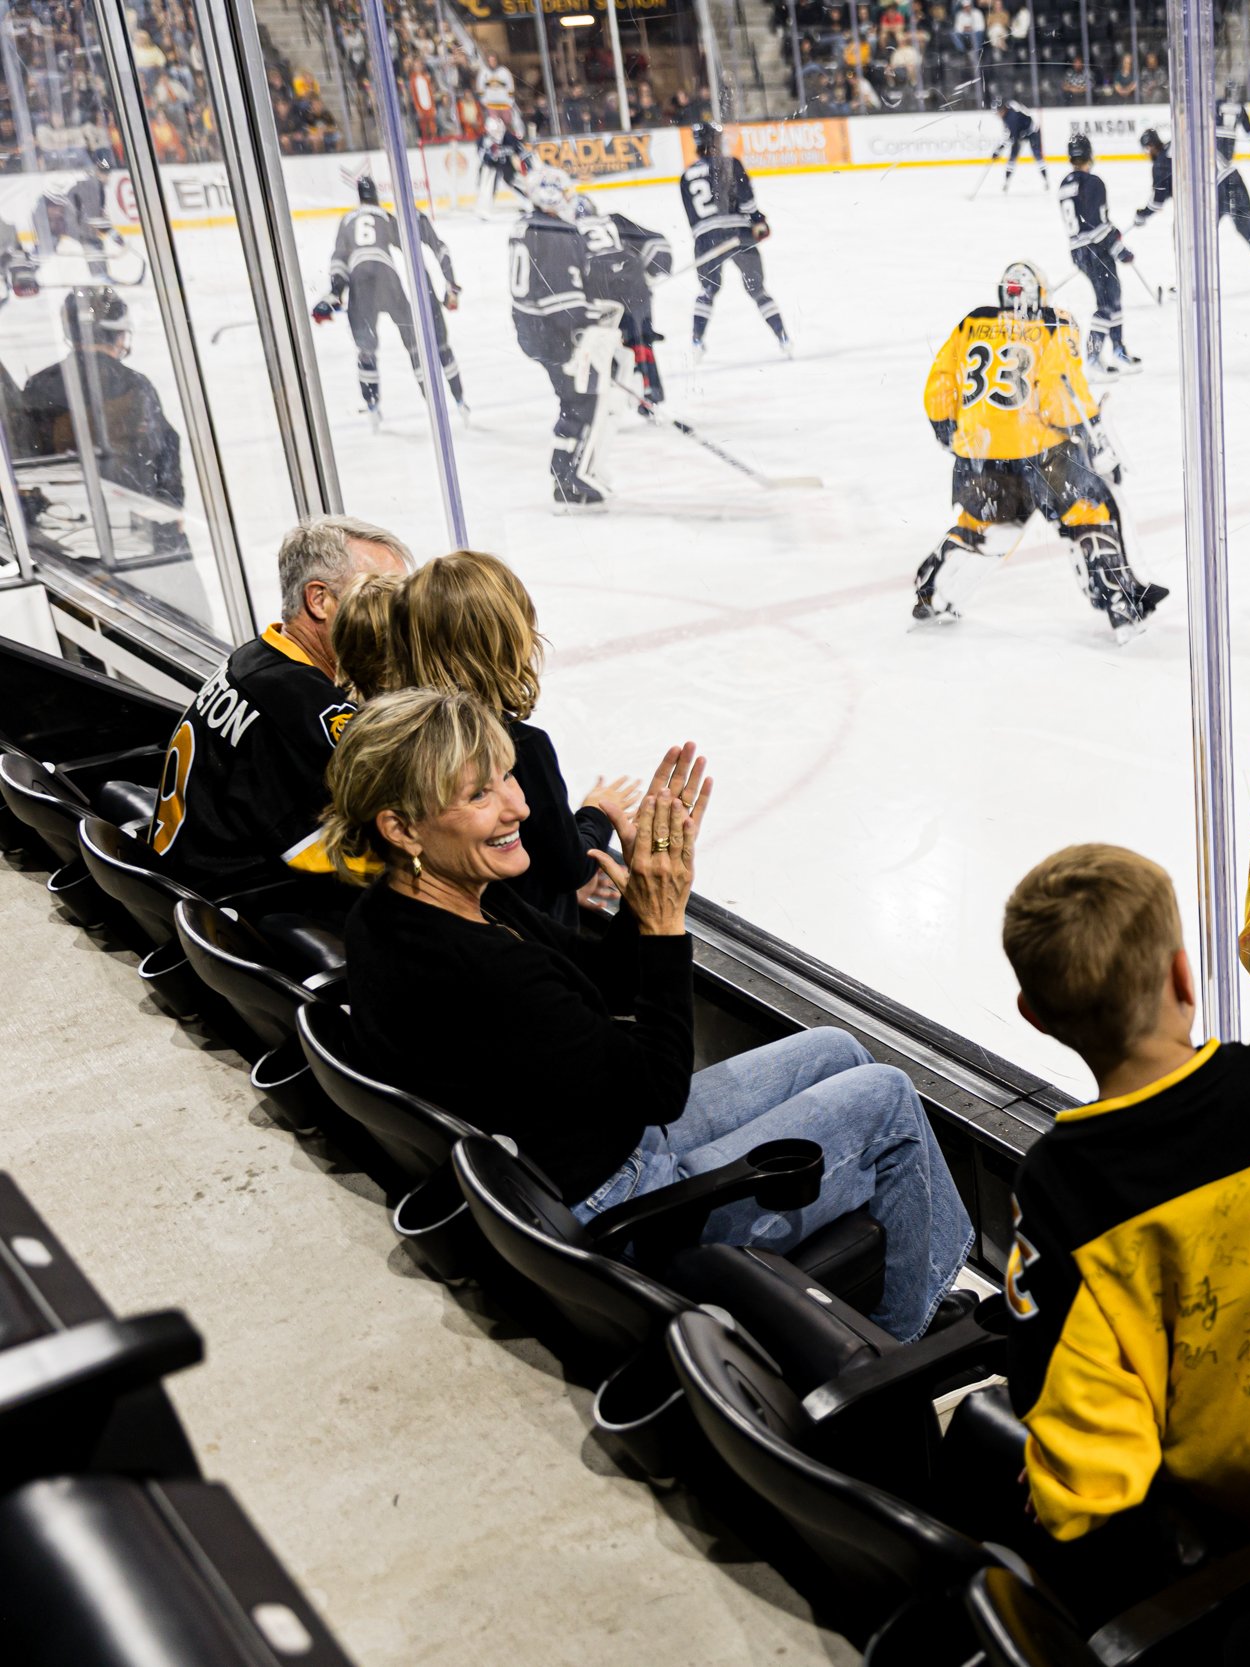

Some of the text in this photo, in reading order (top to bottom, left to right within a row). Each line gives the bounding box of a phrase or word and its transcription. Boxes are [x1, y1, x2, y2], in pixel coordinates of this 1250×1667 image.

[530, 133, 652, 168] RADLEY
[689, 178, 718, 219] 2
[355, 214, 376, 246] 6
[961, 340, 1037, 412] 33
